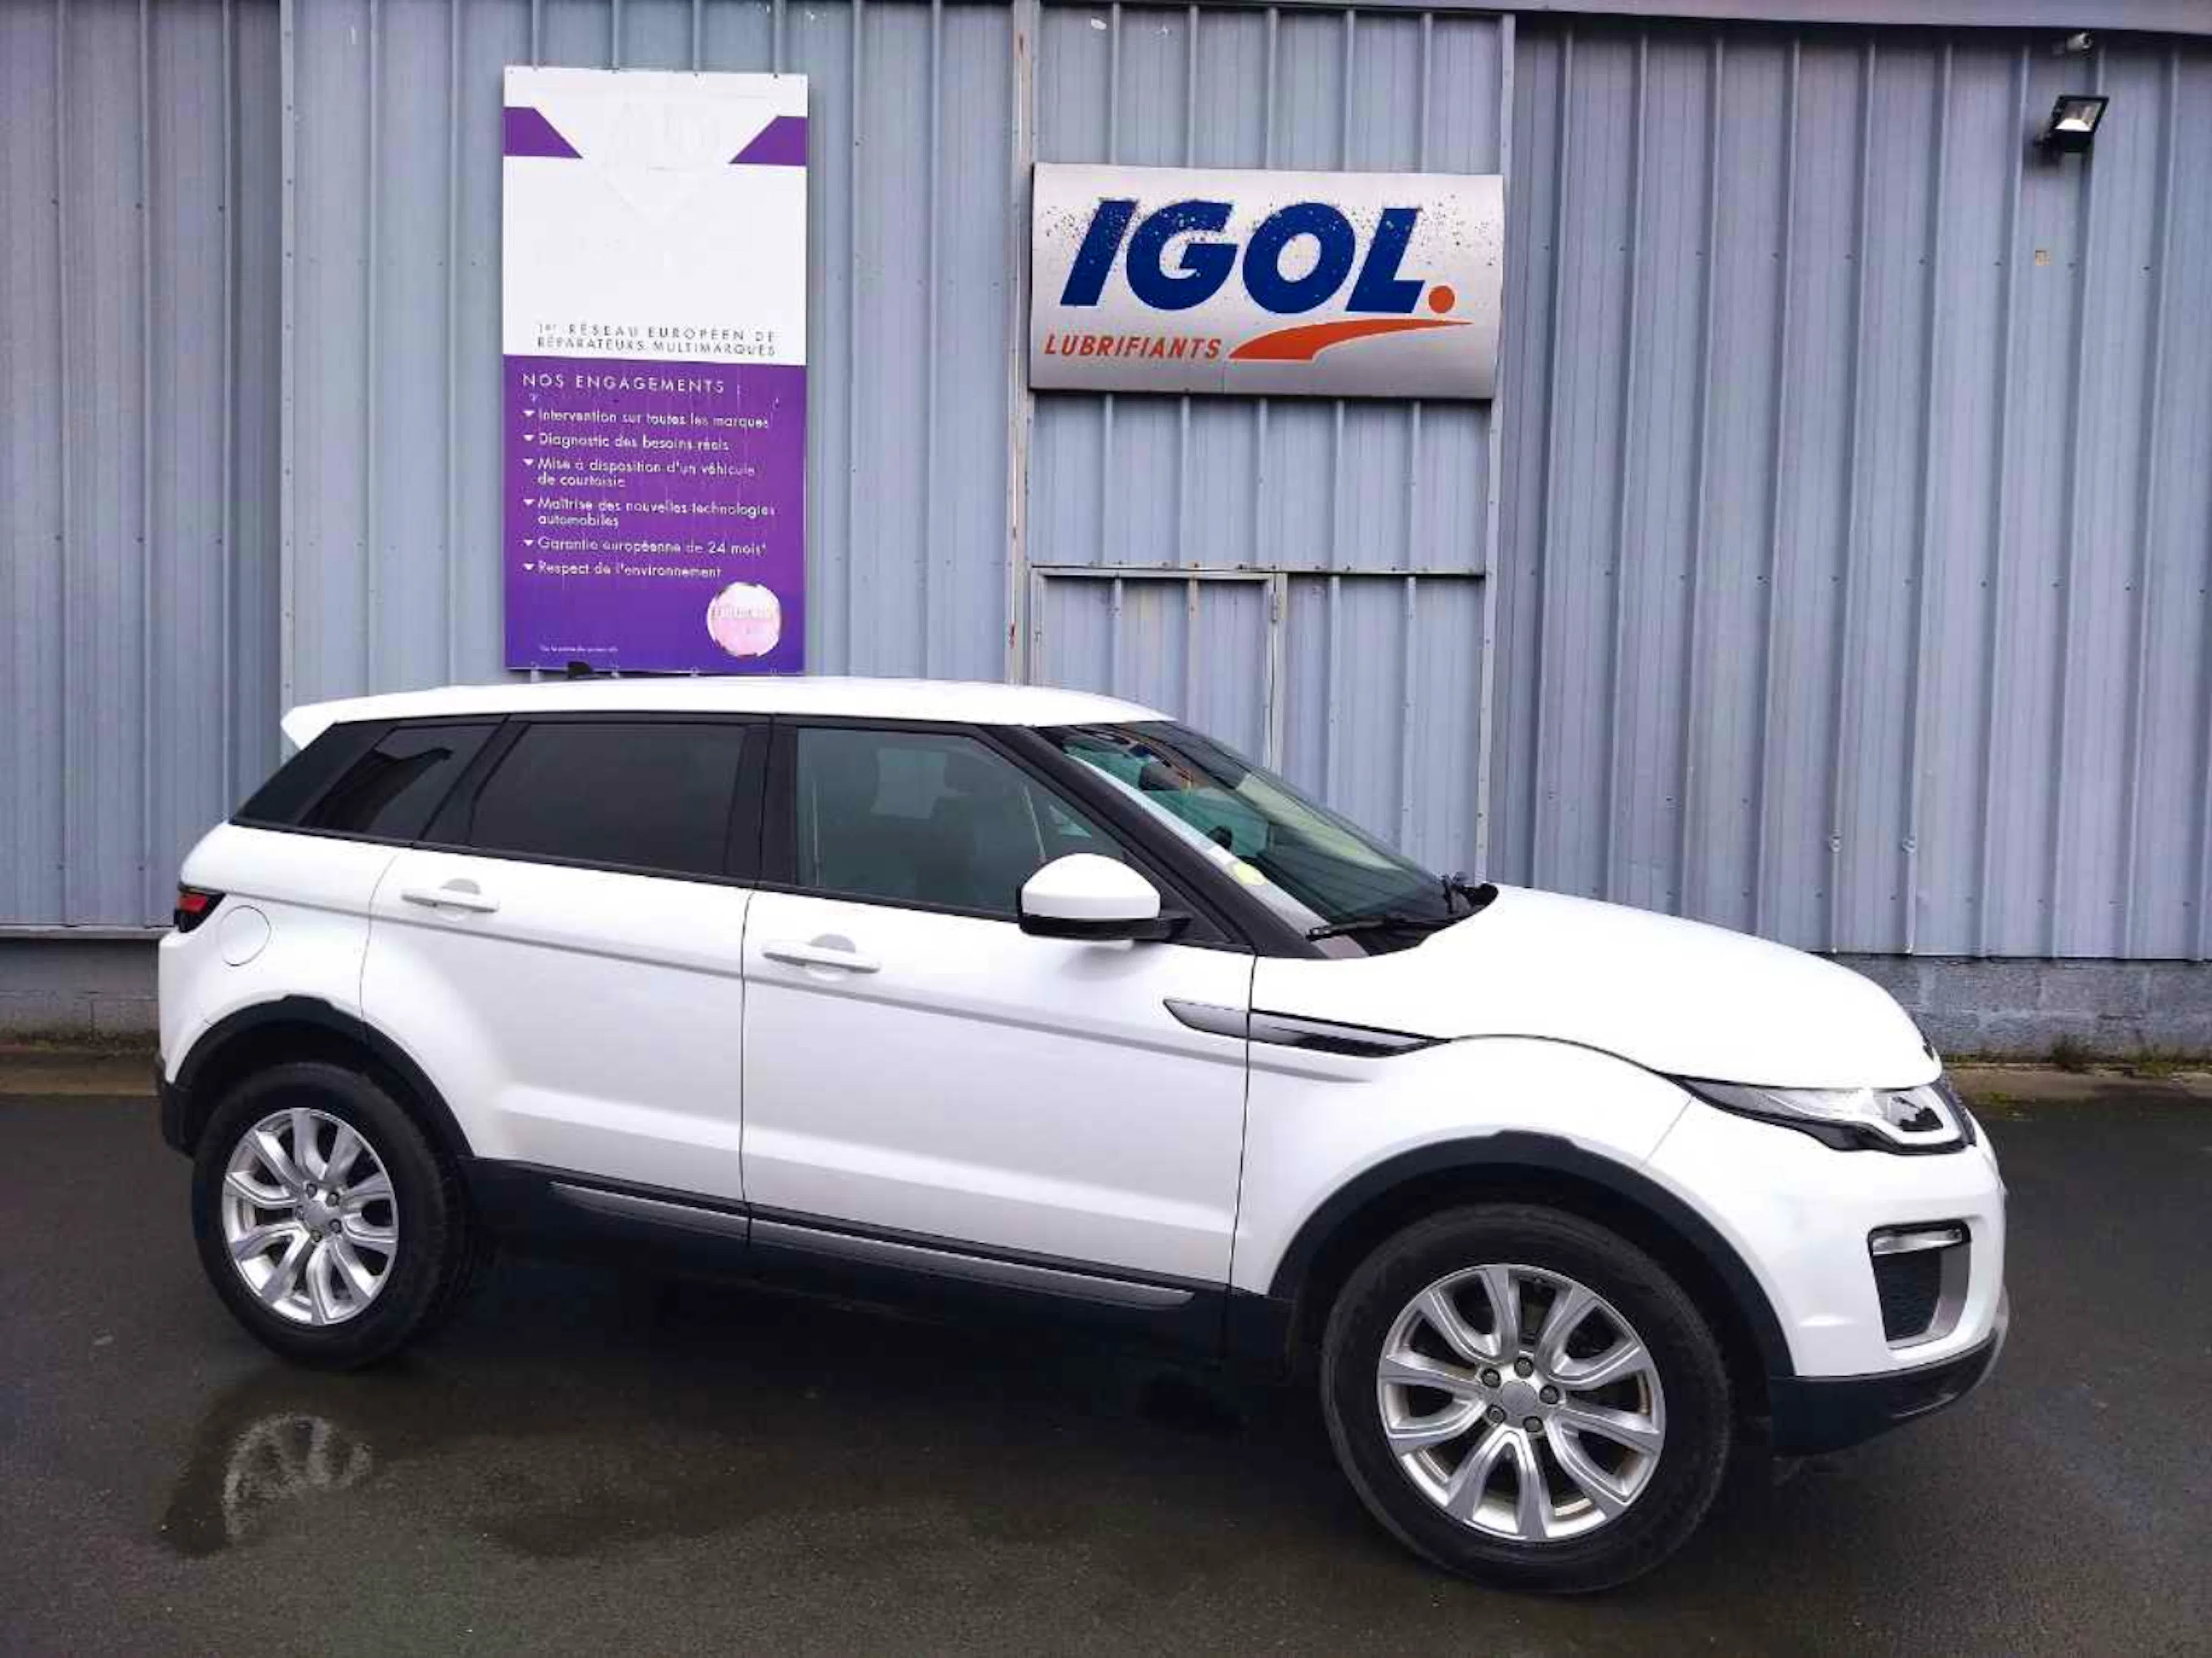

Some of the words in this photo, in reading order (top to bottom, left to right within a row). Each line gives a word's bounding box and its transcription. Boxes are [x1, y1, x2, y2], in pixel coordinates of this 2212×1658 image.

[654, 341, 775, 357] MULTIMARQUES
[1044, 333, 1222, 360] LUBRIFIANTS
[522, 373, 563, 388] NOS
[576, 375, 725, 393] ENGAGEMENTS
[539, 408, 617, 423] Intervention
[623, 414, 641, 423] sur
[647, 412, 687, 425] toutes
[691, 412, 709, 425] les
[713, 416, 768, 434] marques
[539, 433, 609, 449] Diagnostic
[615, 436, 638, 448] des
[643, 434, 692, 451] besoins
[537, 457, 570, 471] Mise
[575, 459, 584, 471] à
[589, 459, 661, 475] disposition
[666, 460, 696, 475] d'un
[702, 461, 756, 477] véhicule
[537, 471, 556, 485] de
[560, 475, 626, 488] courtoisie
[537, 495, 593, 510] Maîtrise
[599, 500, 621, 512] des
[626, 499, 687, 513] nouvelles
[691, 501, 776, 518] technologies
[537, 513, 619, 528] automobiles
[538, 536, 599, 551] Garantie
[603, 540, 681, 555] européenne
[686, 539, 704, 554] de
[707, 540, 726, 554] 24
[538, 560, 589, 576] Respect
[594, 562, 611, 574] de
[615, 563, 722, 578] l'environnement
